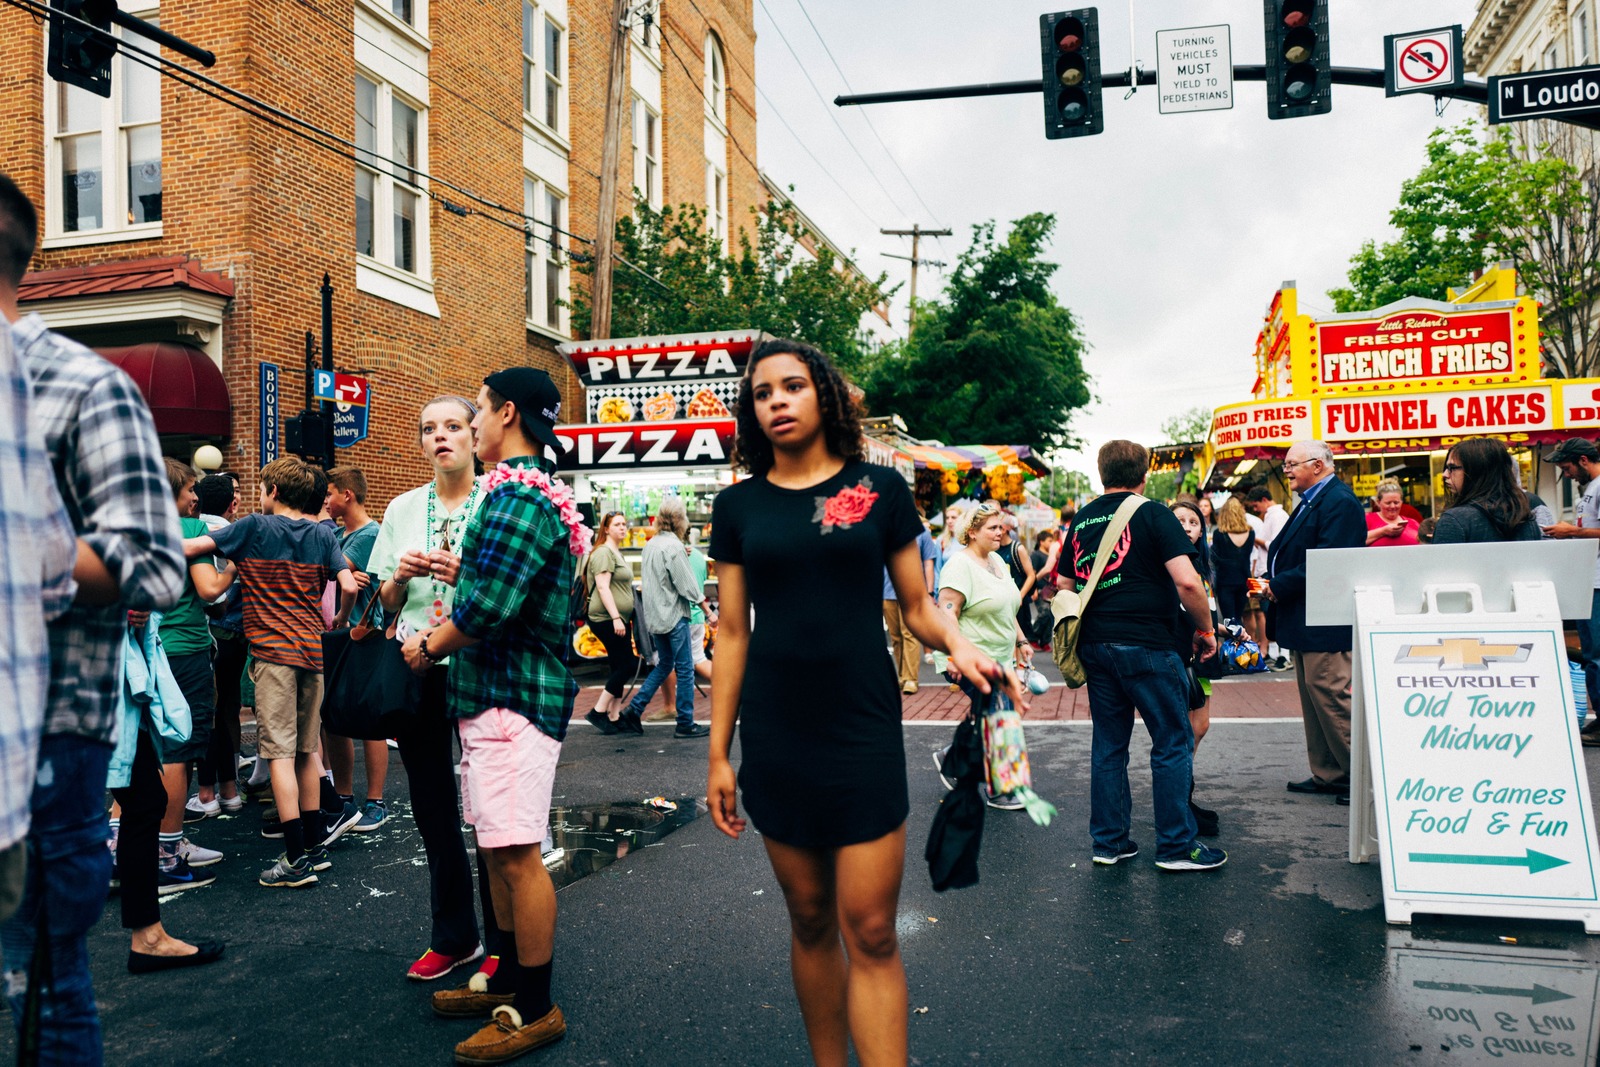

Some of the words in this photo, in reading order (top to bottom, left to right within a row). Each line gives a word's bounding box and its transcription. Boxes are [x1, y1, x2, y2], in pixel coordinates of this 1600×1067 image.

[1172, 36, 1215, 47] TURNING
[1170, 49, 1218, 61] VEHICLES
[1177, 63, 1211, 76] MUST
[1173, 79, 1201, 89] YIELD
[1206, 78, 1218, 87] TO
[1163, 90, 1229, 103] PEDESTRIANS
[1505, 86, 1514, 99] N
[1523, 78, 1600, 108] Loudo
[1376, 322, 1403, 331] Little
[1405, 317, 1448, 329] Richard's
[1344, 332, 1424, 347] FRESH
[1431, 327, 1483, 341] CUT
[588, 349, 738, 381] PIZZA
[1323, 347, 1423, 382] FRENCH
[1430, 341, 1509, 374] FRIES
[319, 373, 331, 394] P
[333, 412, 355, 423] Book
[1254, 406, 1307, 423] FRIES
[1326, 399, 1437, 434] FUNNEL
[1447, 393, 1546, 428] CAKES
[1569, 406, 1600, 421] D
[1217, 429, 1241, 445] CORN
[1247, 424, 1293, 440] DOGS
[1345, 438, 1429, 450] CORN
[1086, 515, 1107, 526] Lunch
[1397, 676, 1540, 688] CHEVROLET
[1404, 691, 1453, 718] Old
[1467, 694, 1536, 718] Town
[1420, 723, 1533, 759] Midway
[1396, 778, 1464, 803] More
[1472, 779, 1567, 805] Games
[1405, 808, 1472, 834] Food
[1487, 812, 1511, 835] &
[1519, 812, 1569, 837] Fun
